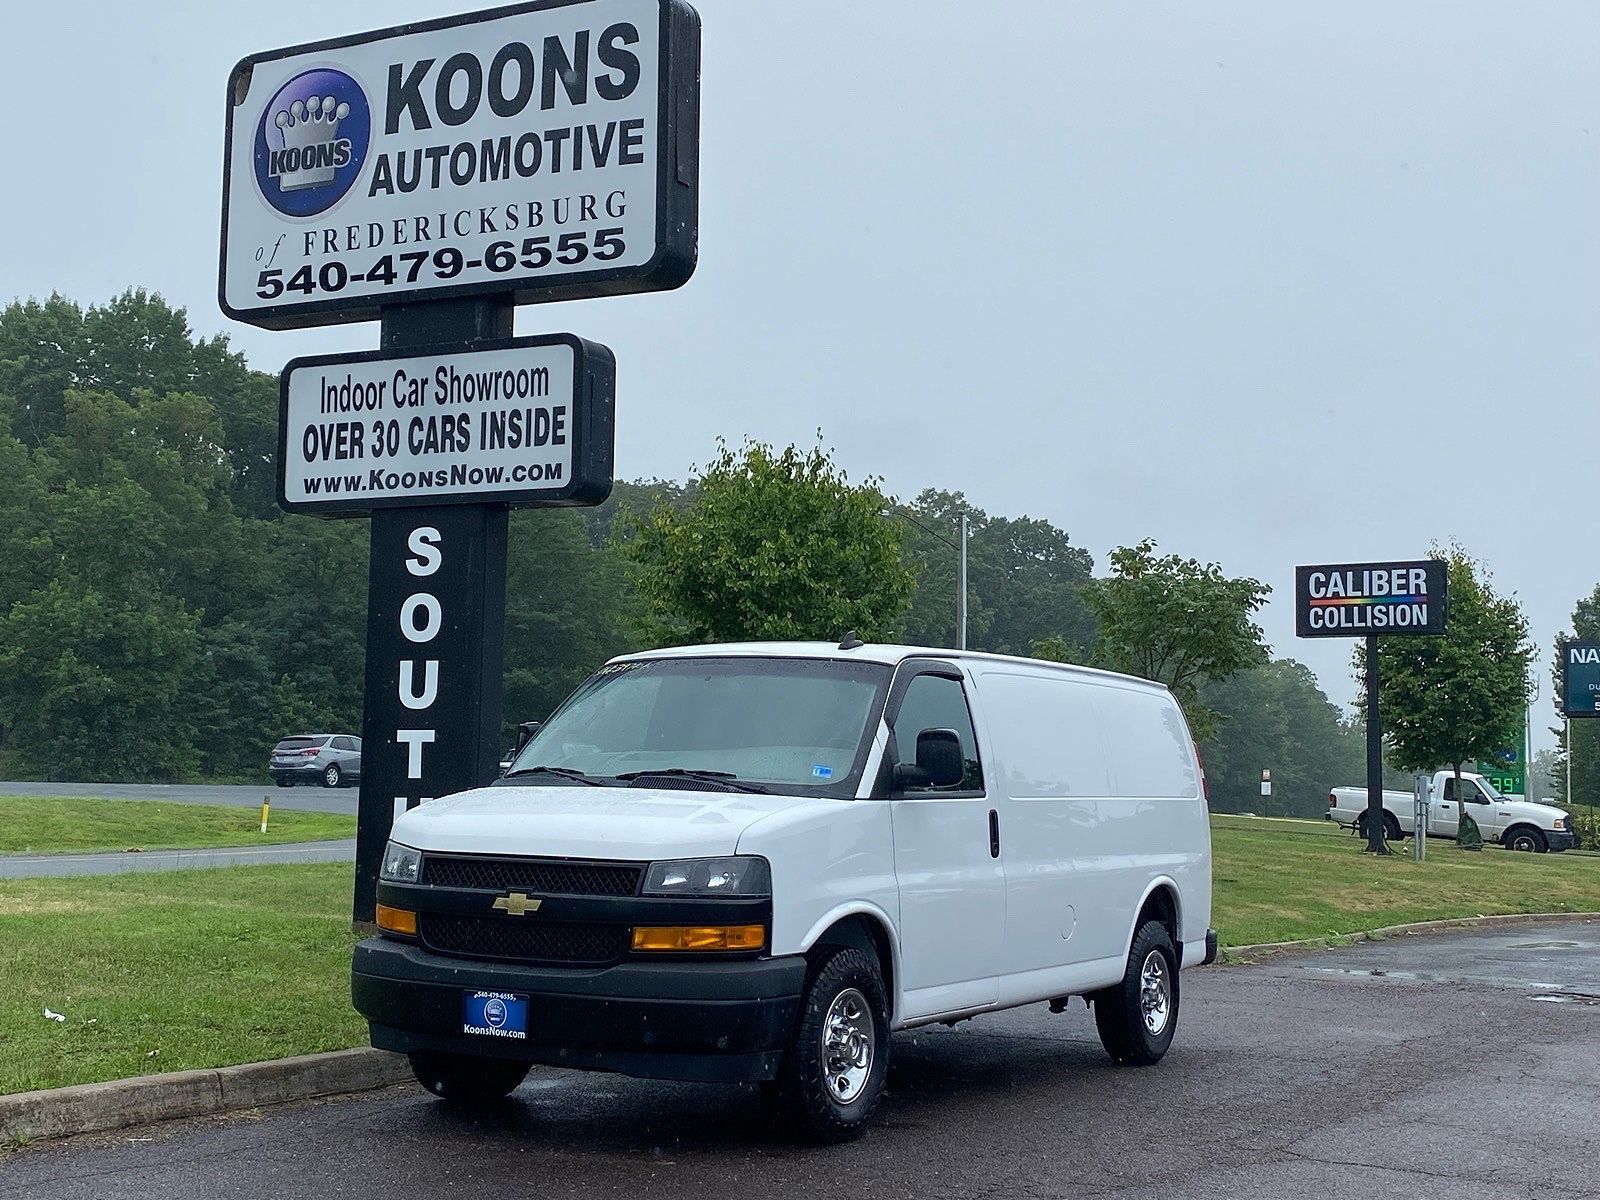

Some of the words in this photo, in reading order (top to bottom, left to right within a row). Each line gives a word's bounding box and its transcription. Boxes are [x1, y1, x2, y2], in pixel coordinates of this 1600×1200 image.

[384, 22, 641, 134] KOONS
[270, 139, 352, 176] KOONS
[368, 118, 645, 198] AUTOMOTIVE
[255, 233, 286, 268] of
[303, 190, 627, 257] FREDERICKSBURG
[256, 227, 626, 299] 540-479-6555
[320, 373, 386, 414] Indoor
[392, 368, 429, 409] Car
[434, 364, 550, 406] Showroom
[302, 420, 365, 464] OVER
[371, 417, 400, 458] 30
[407, 411, 471, 456] CARS
[479, 405, 567, 451] INSIDE
[1308, 568, 1428, 599] CALIBER
[1309, 604, 1428, 629] COLLISION
[463, 1024, 526, 1039] KoonsNow.com
